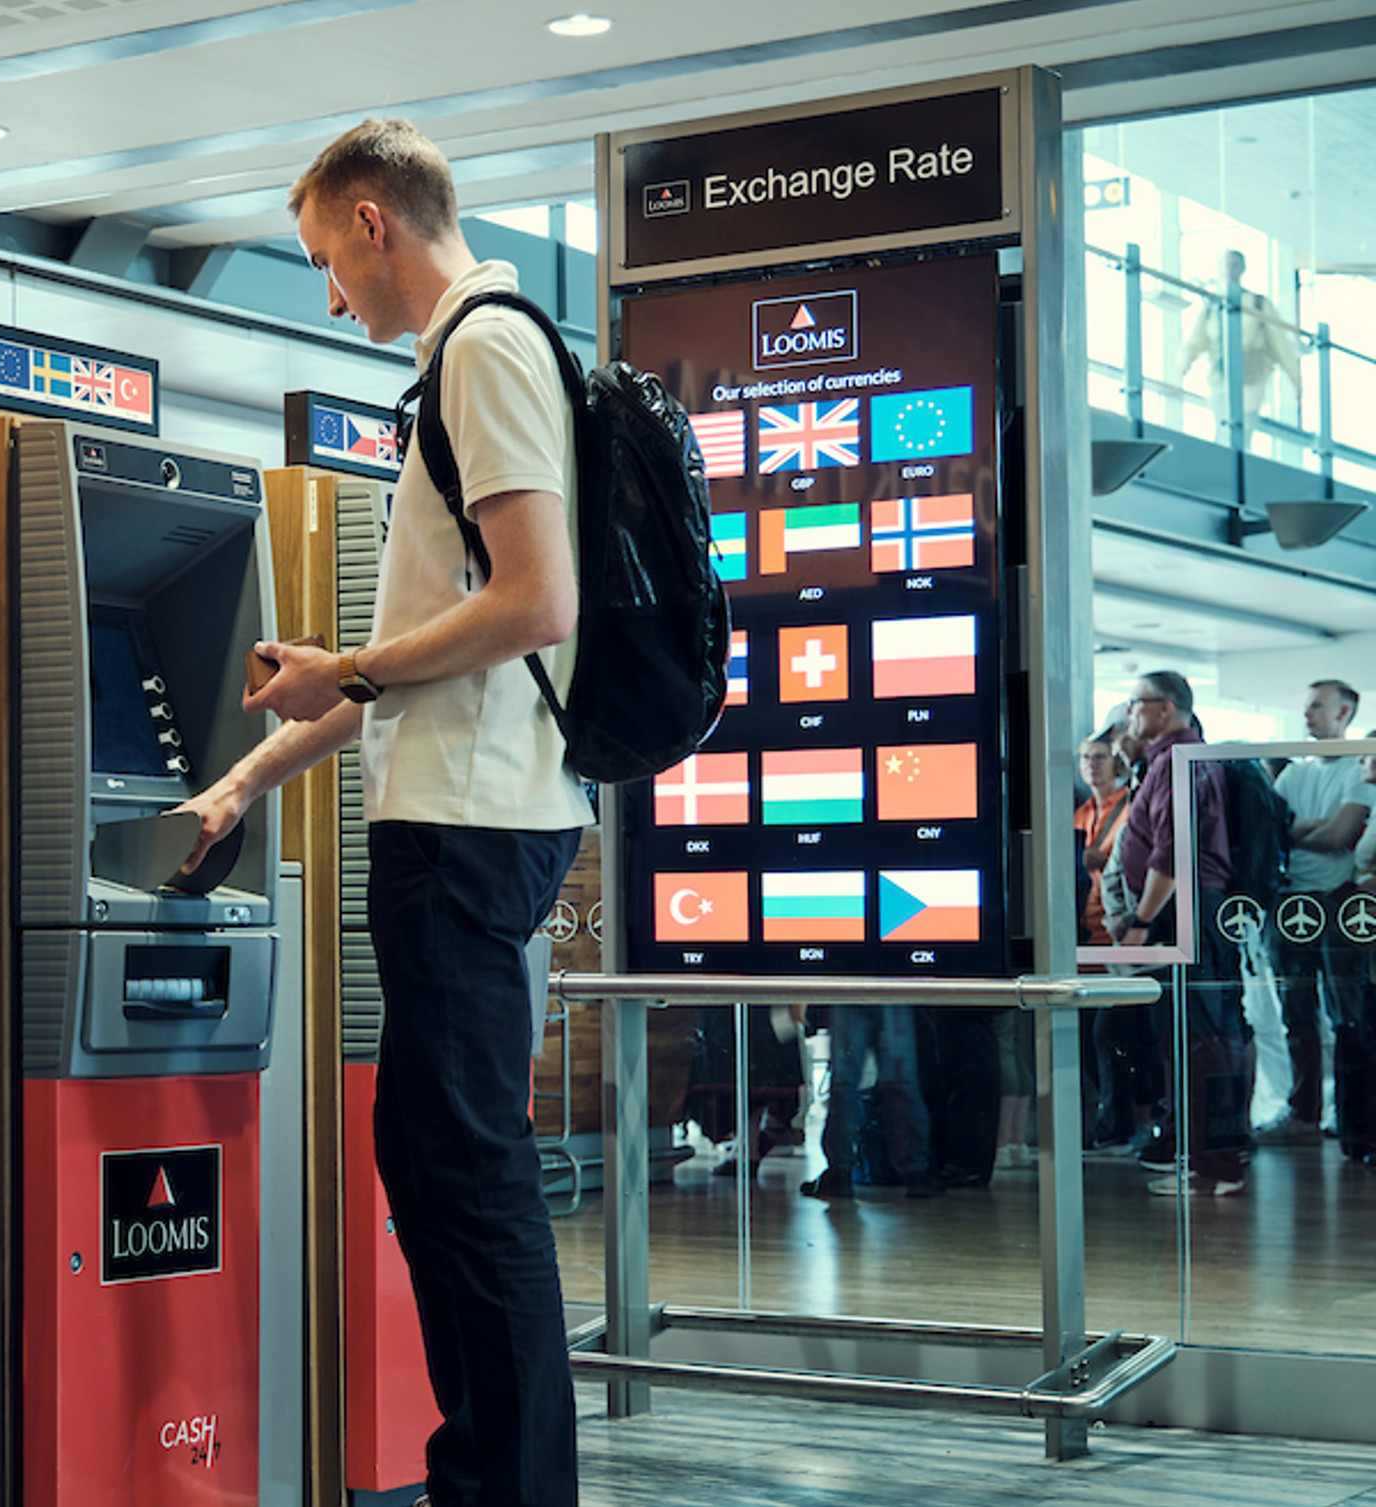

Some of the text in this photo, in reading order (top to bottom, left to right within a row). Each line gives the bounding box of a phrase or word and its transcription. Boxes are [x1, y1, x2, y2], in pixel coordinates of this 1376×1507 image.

[704, 144, 974, 209] Exchange Rate
[761, 327, 847, 356] LOOMIS
[712, 368, 902, 402] Our selection of currencies
[902, 464, 935, 479] EURO
[791, 477, 816, 490] GBP
[906, 576, 933, 589] NOK
[799, 587, 824, 600] AED
[799, 715, 823, 728] CHF
[907, 709, 929, 722] PLN
[797, 832, 822, 844] HUF
[916, 827, 942, 839] CNY
[686, 840, 710, 853] DKK
[682, 952, 704, 964] TRY
[799, 948, 824, 960] BGN
[910, 951, 935, 963] CZK
[112, 1216, 209, 1258] LOOMIS
[160, 1414, 216, 1467] CASH
